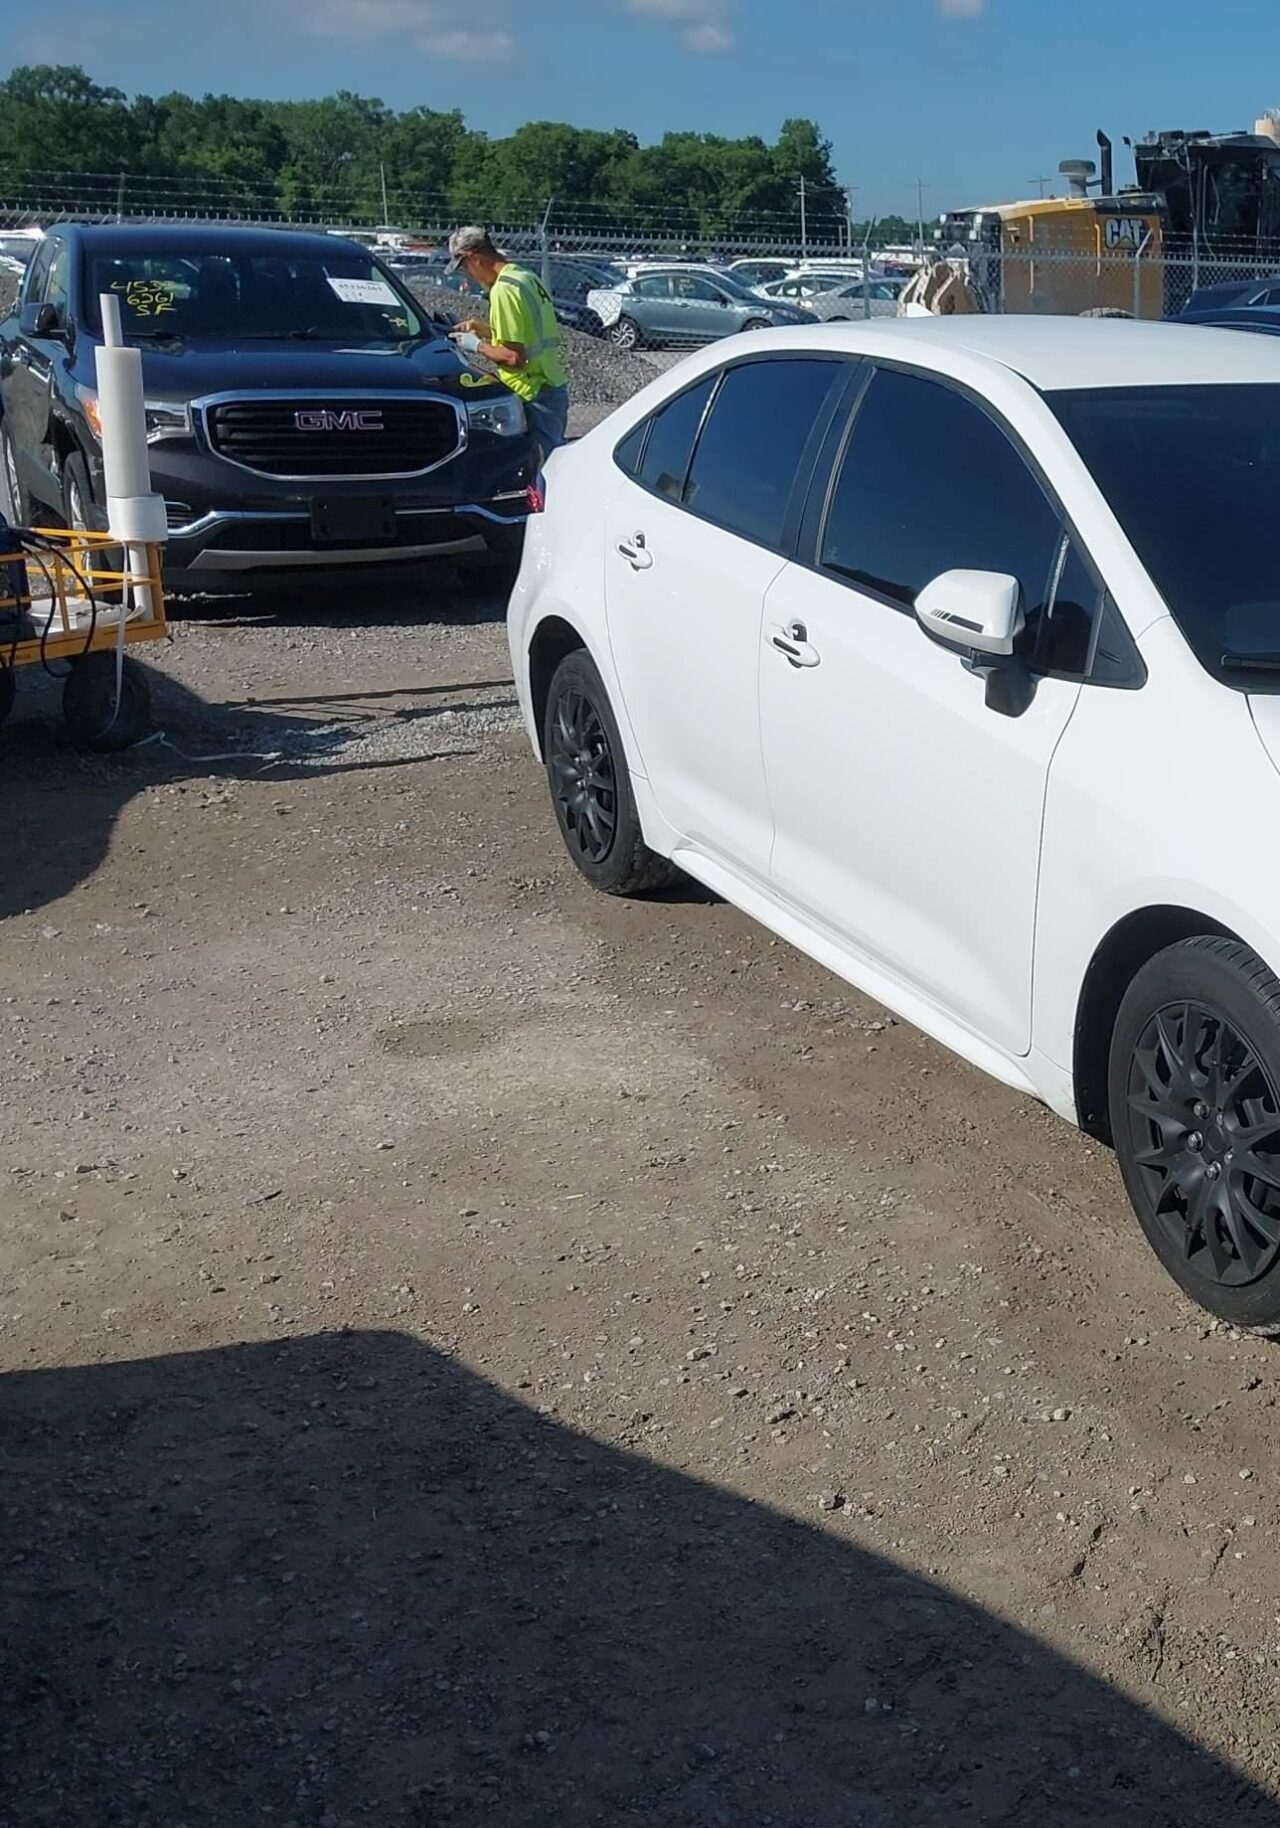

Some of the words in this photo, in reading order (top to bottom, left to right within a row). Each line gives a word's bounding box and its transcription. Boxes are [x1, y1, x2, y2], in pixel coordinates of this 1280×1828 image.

[1105, 218, 1143, 249] CAT
[127, 291, 174, 305] 6261
[294, 410, 384, 430] GMC
